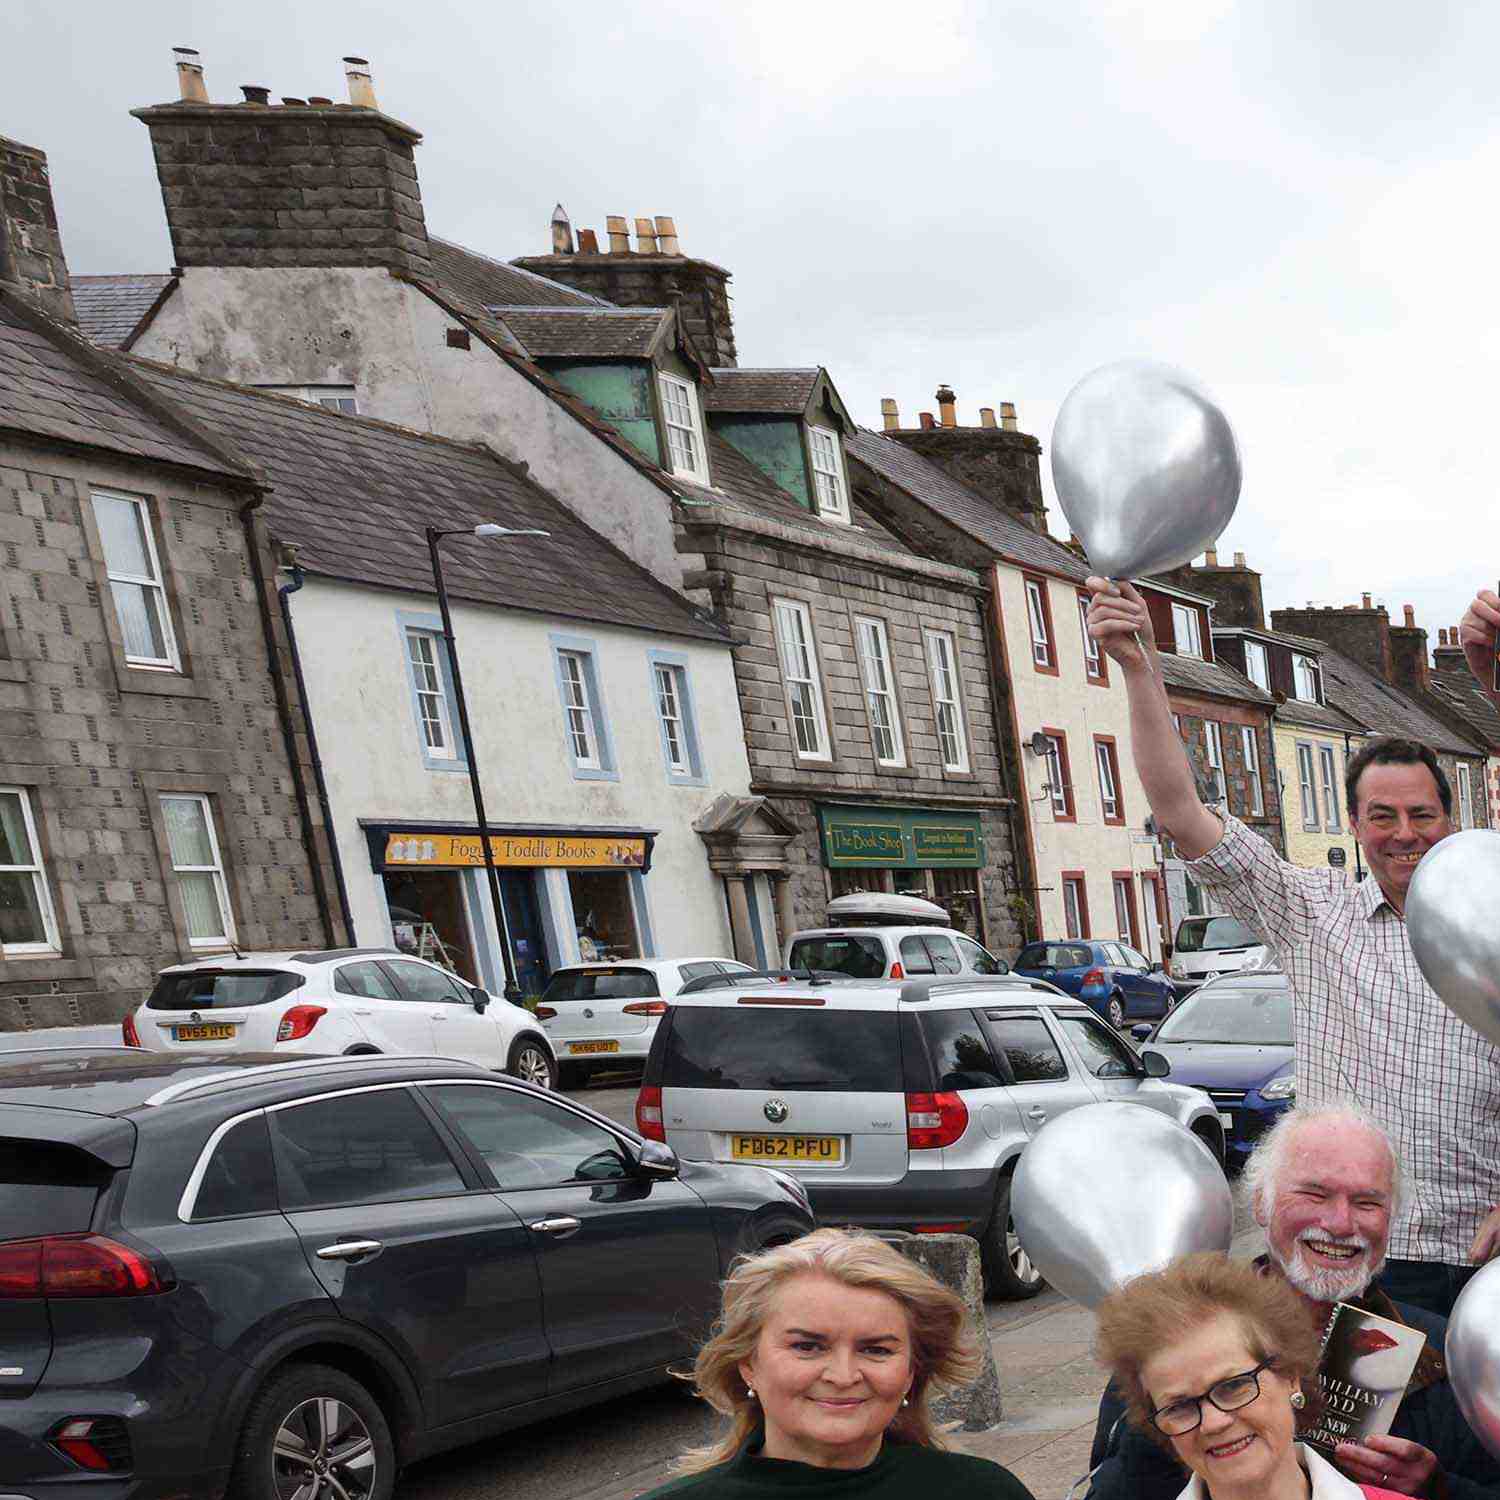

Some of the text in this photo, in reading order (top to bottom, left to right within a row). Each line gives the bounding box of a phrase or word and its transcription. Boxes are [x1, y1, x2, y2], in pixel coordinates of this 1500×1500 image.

[831, 830, 850, 849] The
[853, 830, 876, 850] Book
[879, 832, 901, 850] Shop
[449, 839, 596, 863] Fogge Toddle Books
[792, 1137, 832, 1156] PFU
[1324, 1417, 1350, 1434] NEW
